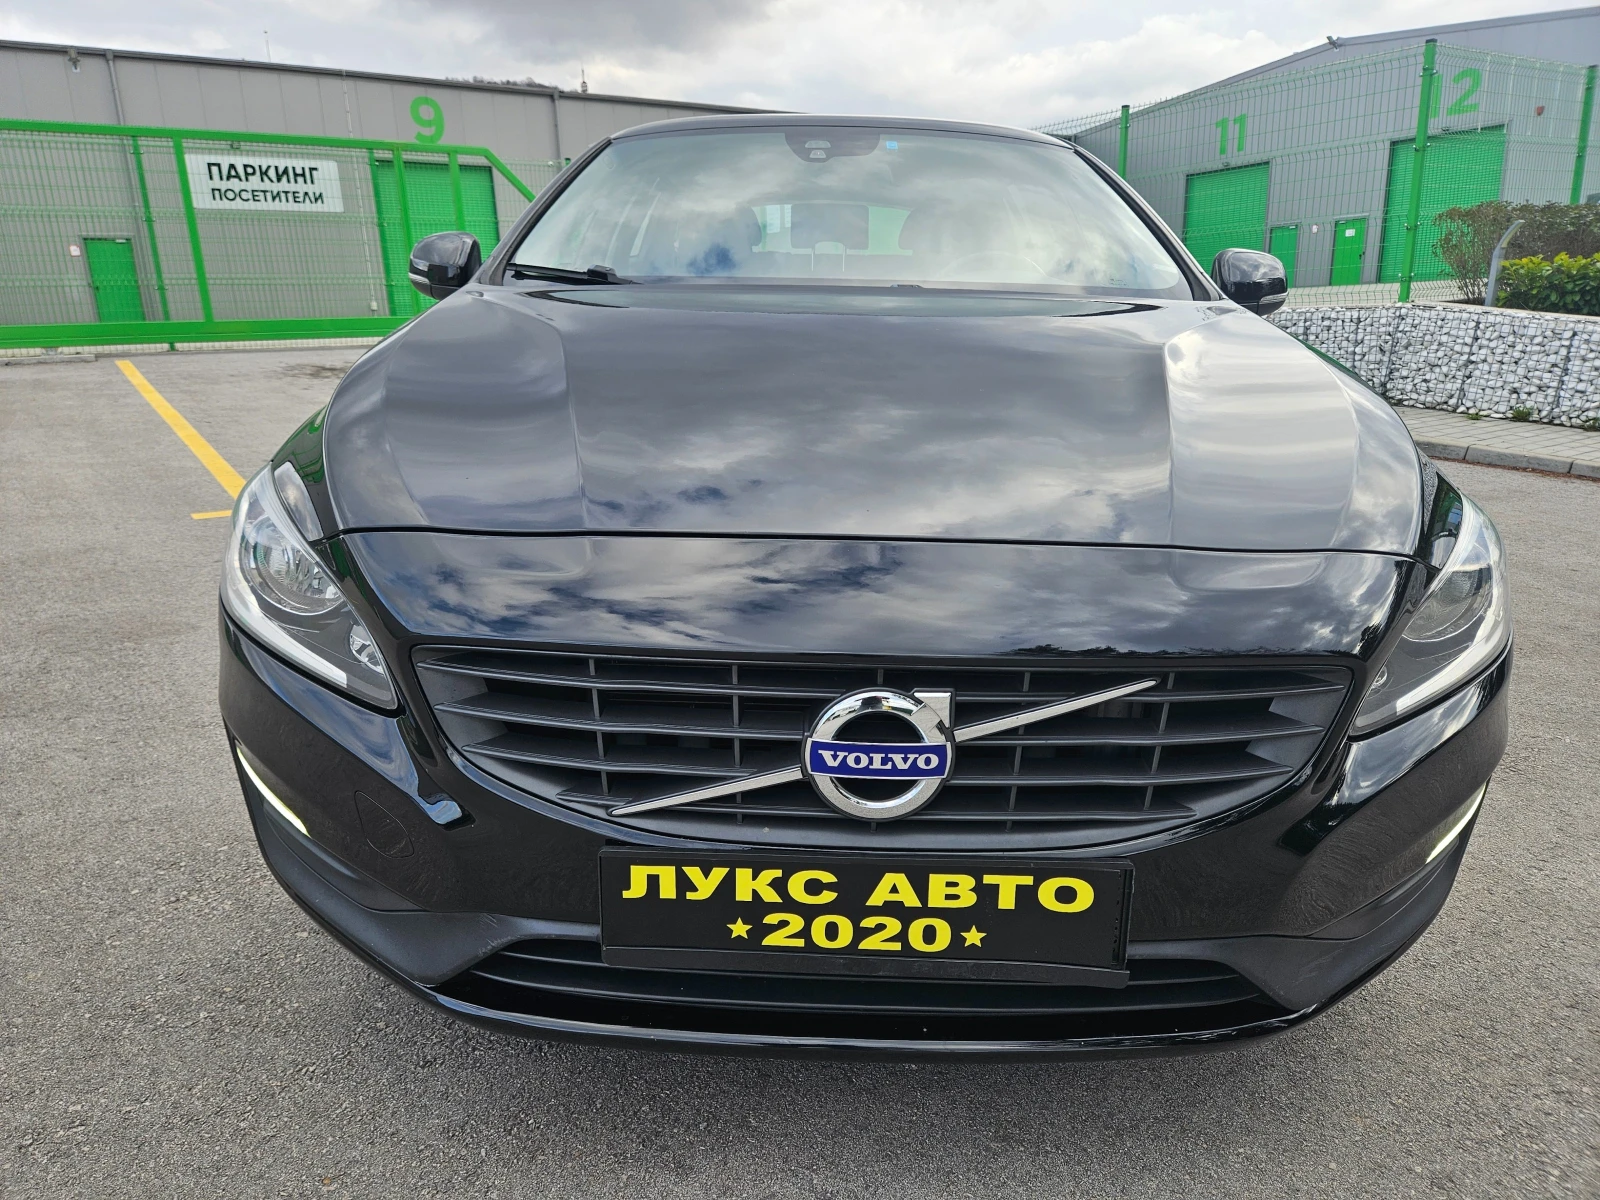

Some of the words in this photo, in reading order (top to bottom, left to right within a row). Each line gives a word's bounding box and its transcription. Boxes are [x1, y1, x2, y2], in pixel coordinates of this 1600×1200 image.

[409, 95, 445, 145] 9
[1215, 113, 1247, 155] 11
[206, 162, 319, 185] ПАРКИНГ
[211, 188, 325, 205] ПОСЕТИТЕЛИ
[818, 749, 940, 770] VOLVO
[621, 865, 839, 905] ЛУКС
[865, 873, 1095, 913] АВТО
[761, 912, 952, 953] 2020
